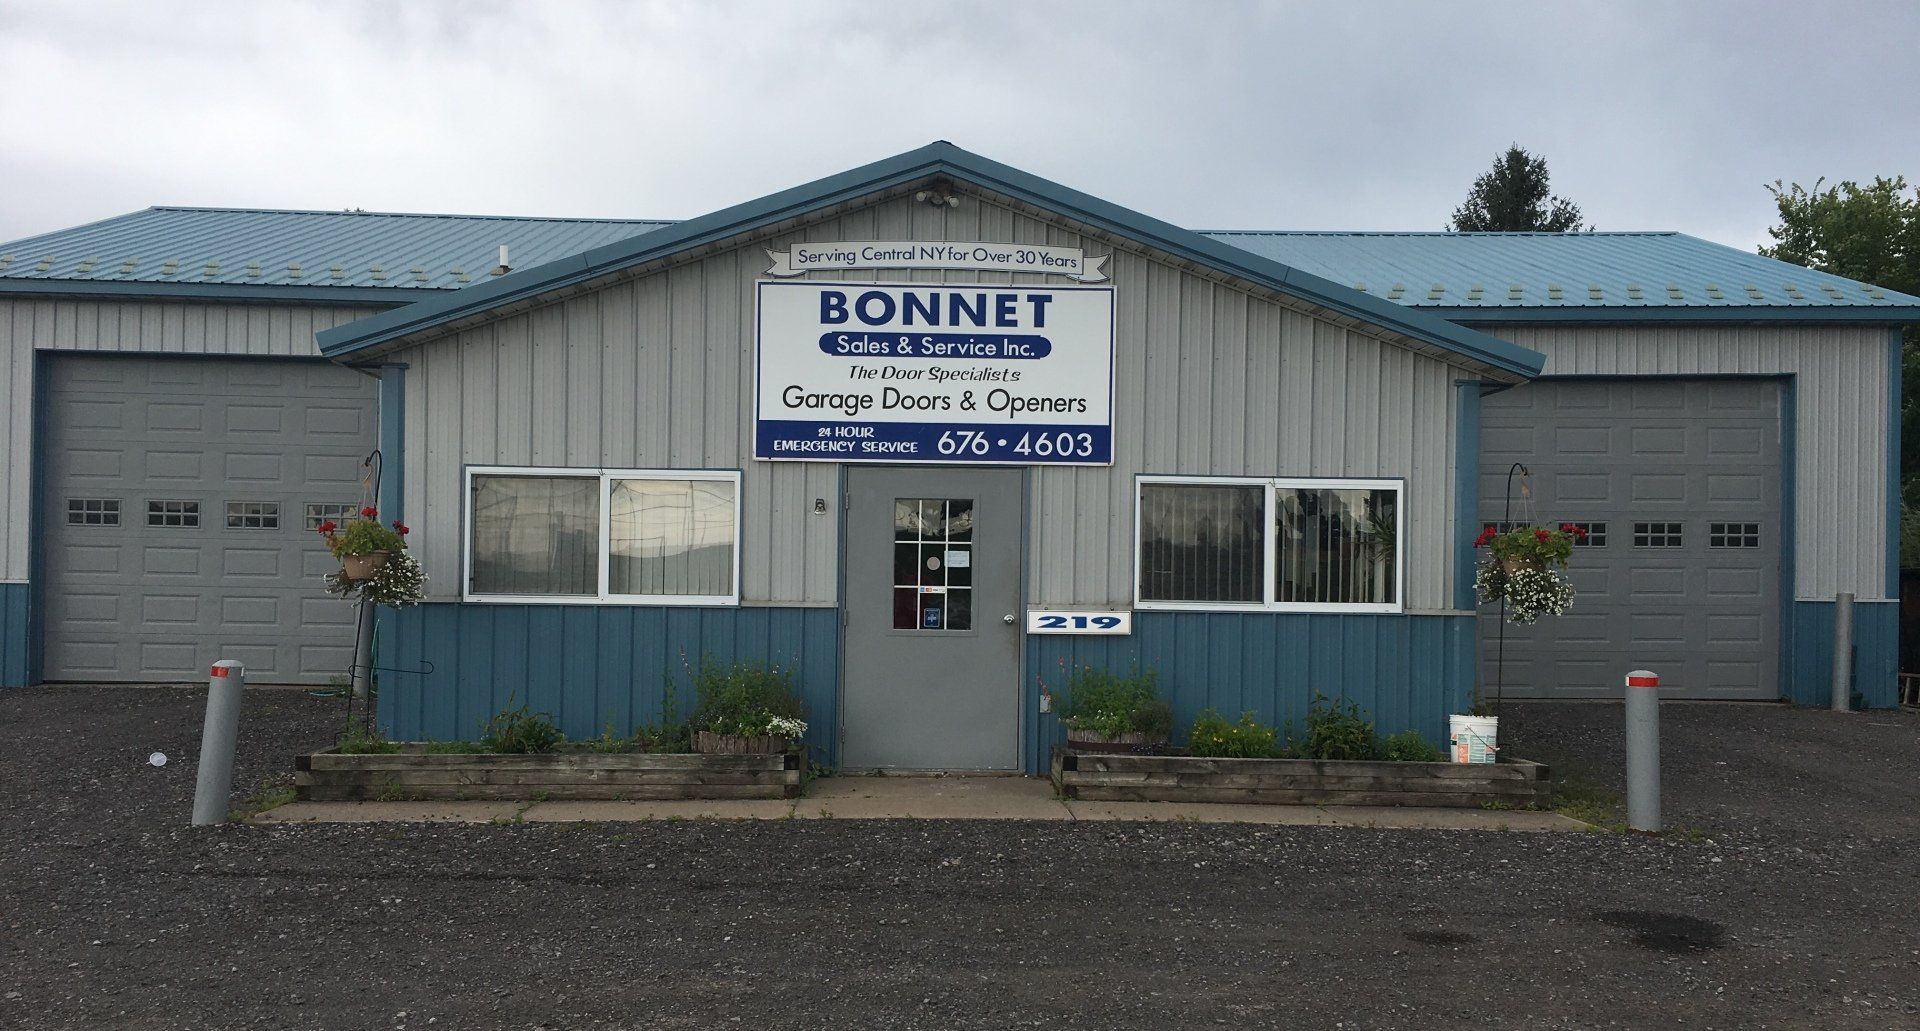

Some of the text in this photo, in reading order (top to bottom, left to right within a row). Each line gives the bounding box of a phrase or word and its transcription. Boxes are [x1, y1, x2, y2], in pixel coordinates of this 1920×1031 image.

[798, 246, 1077, 268] Serving Central NY for Over 30 Years
[820, 290, 1053, 328] BONNET
[836, 336, 1035, 356] Sales & Service Inc.
[849, 366, 1021, 383] The Door Specialists
[783, 385, 1087, 418] Garage Doors & Openers
[818, 427, 874, 438] 24 HOUR
[773, 440, 918, 453] EMERGENCY SERVICE
[938, 431, 1093, 456] 676 4603
[1037, 616, 1121, 628] 219
